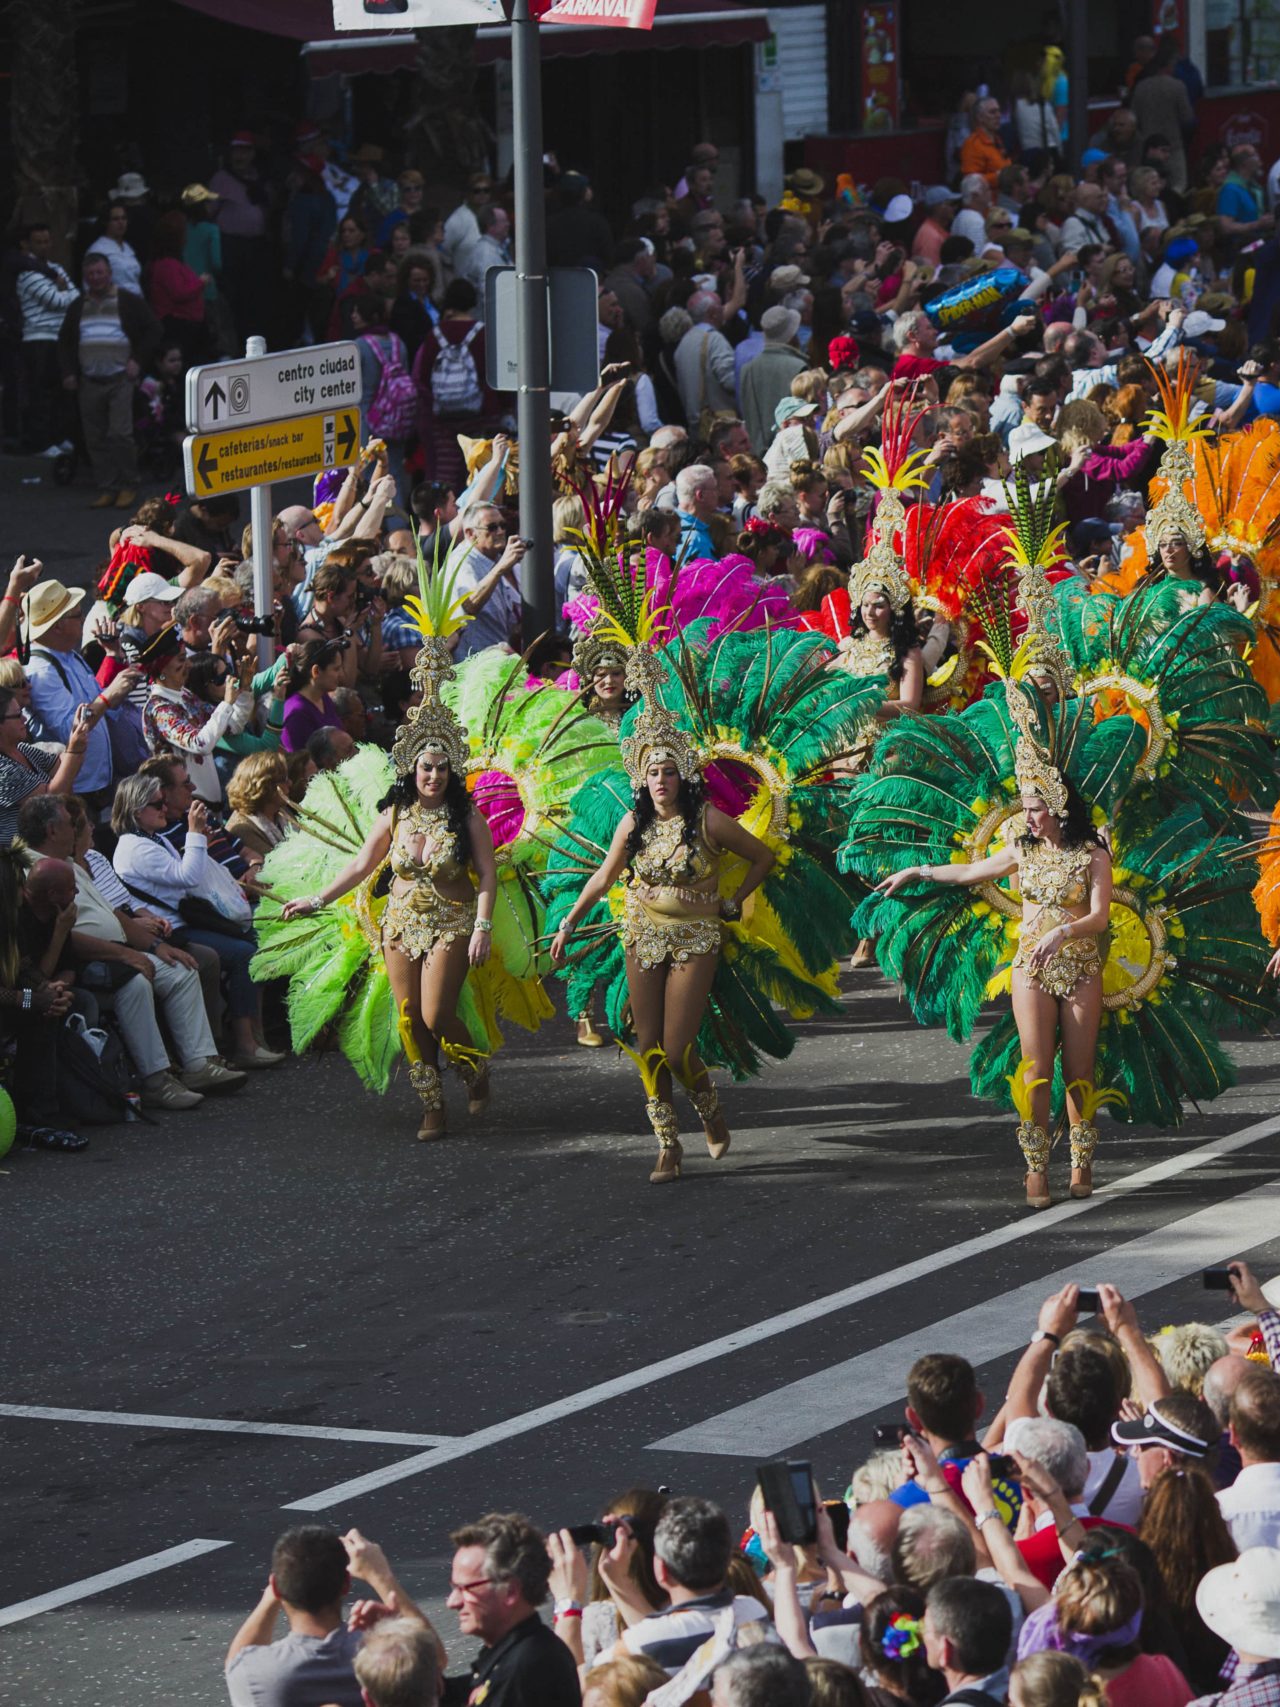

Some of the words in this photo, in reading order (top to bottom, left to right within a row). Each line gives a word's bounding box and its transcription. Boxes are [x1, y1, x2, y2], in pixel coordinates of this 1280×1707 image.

[278, 363, 314, 383] centro
[319, 355, 355, 376] ciudad
[294, 385, 315, 405] city
[321, 379, 356, 399] center
[292, 432, 304, 443] bar
[220, 453, 321, 482] restaurantes/restaurants
